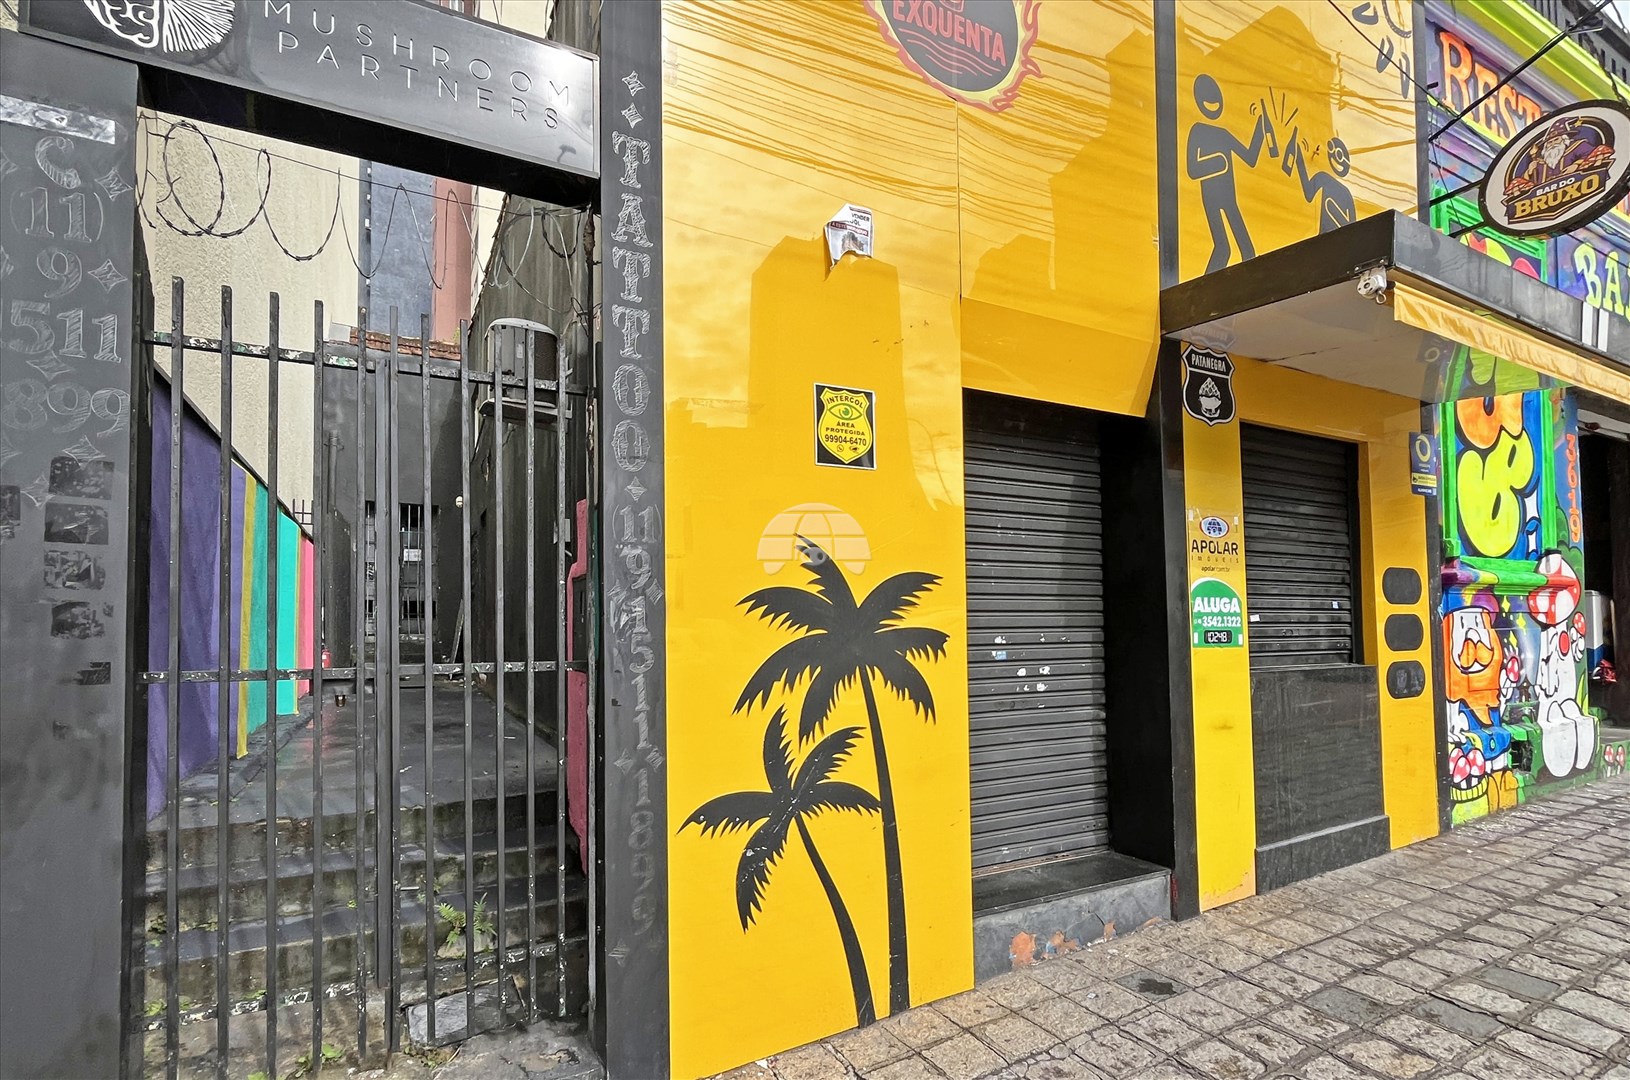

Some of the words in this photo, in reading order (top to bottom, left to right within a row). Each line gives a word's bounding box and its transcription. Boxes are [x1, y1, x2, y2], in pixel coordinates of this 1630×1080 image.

[263, 0, 570, 106] MUSHROOM
[893, 0, 1007, 67] EXQUENTA
[278, 29, 558, 130] PARTNERS
[1439, 31, 1550, 141] REST
[1514, 174, 1601, 218] BRUXO
[1536, 183, 1558, 196] BAR
[1558, 177, 1576, 189] DO
[10, 186, 104, 243] (11)
[36, 250, 83, 298] 9
[1573, 242, 1630, 322] BA
[611, 130, 654, 473] TATTOO
[1191, 353, 1227, 372] PATANEGRA
[826, 395, 864, 409] INTERCOL
[824, 434, 867, 446] 99904-6470
[825, 427, 866, 436] PROTEGIDA
[1191, 539, 1239, 556] APOLAR
[1193, 596, 1241, 613] ALUGA
[1202, 615, 1242, 627] 3542.1322
